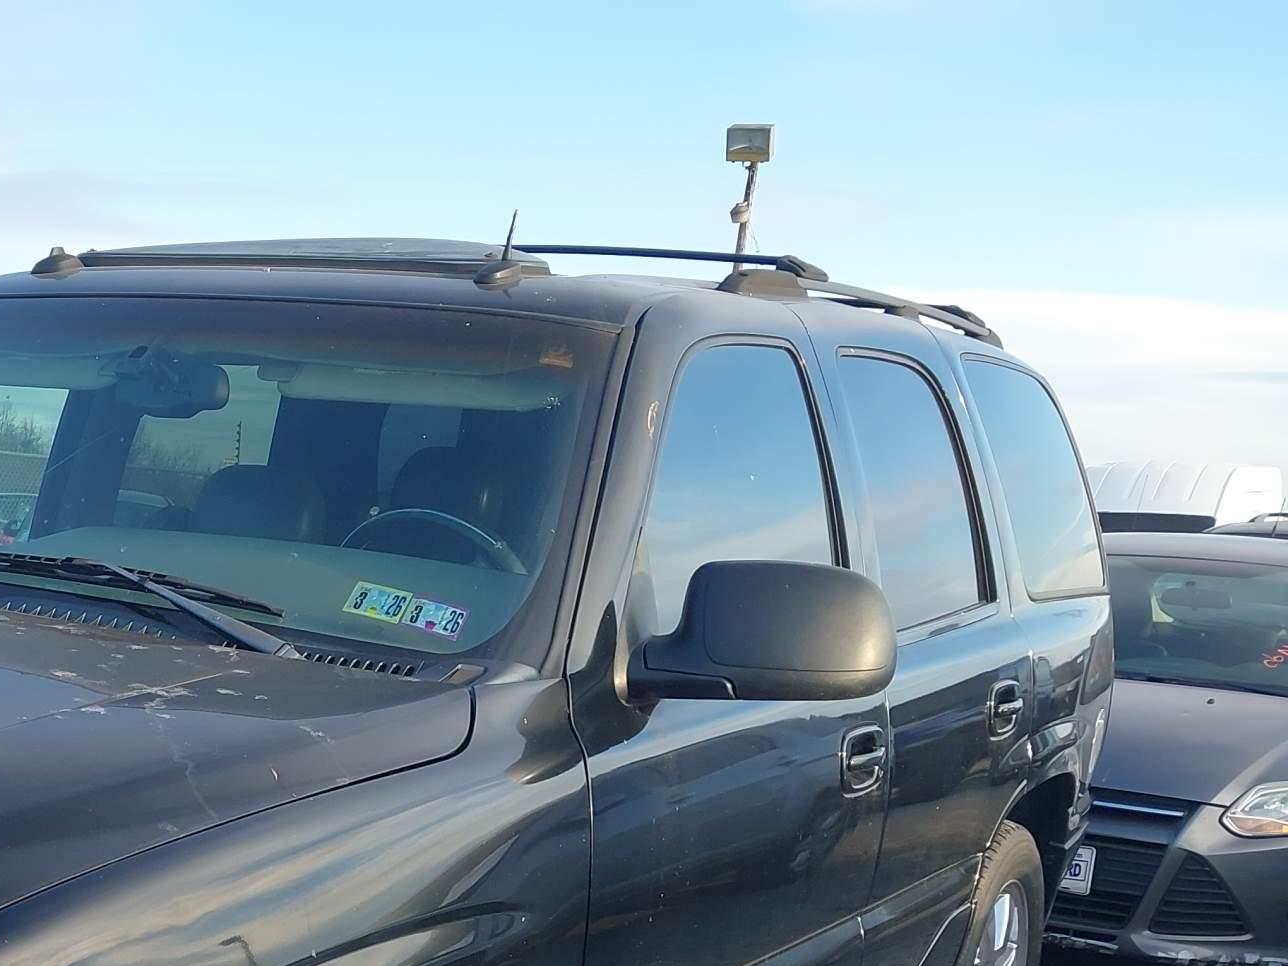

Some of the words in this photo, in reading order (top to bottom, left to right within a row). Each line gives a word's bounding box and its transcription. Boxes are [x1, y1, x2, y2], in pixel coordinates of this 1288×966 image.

[353, 591, 368, 610] 3
[384, 594, 406, 617] 26
[409, 605, 423, 624] 3
[443, 610, 464, 634] 26
